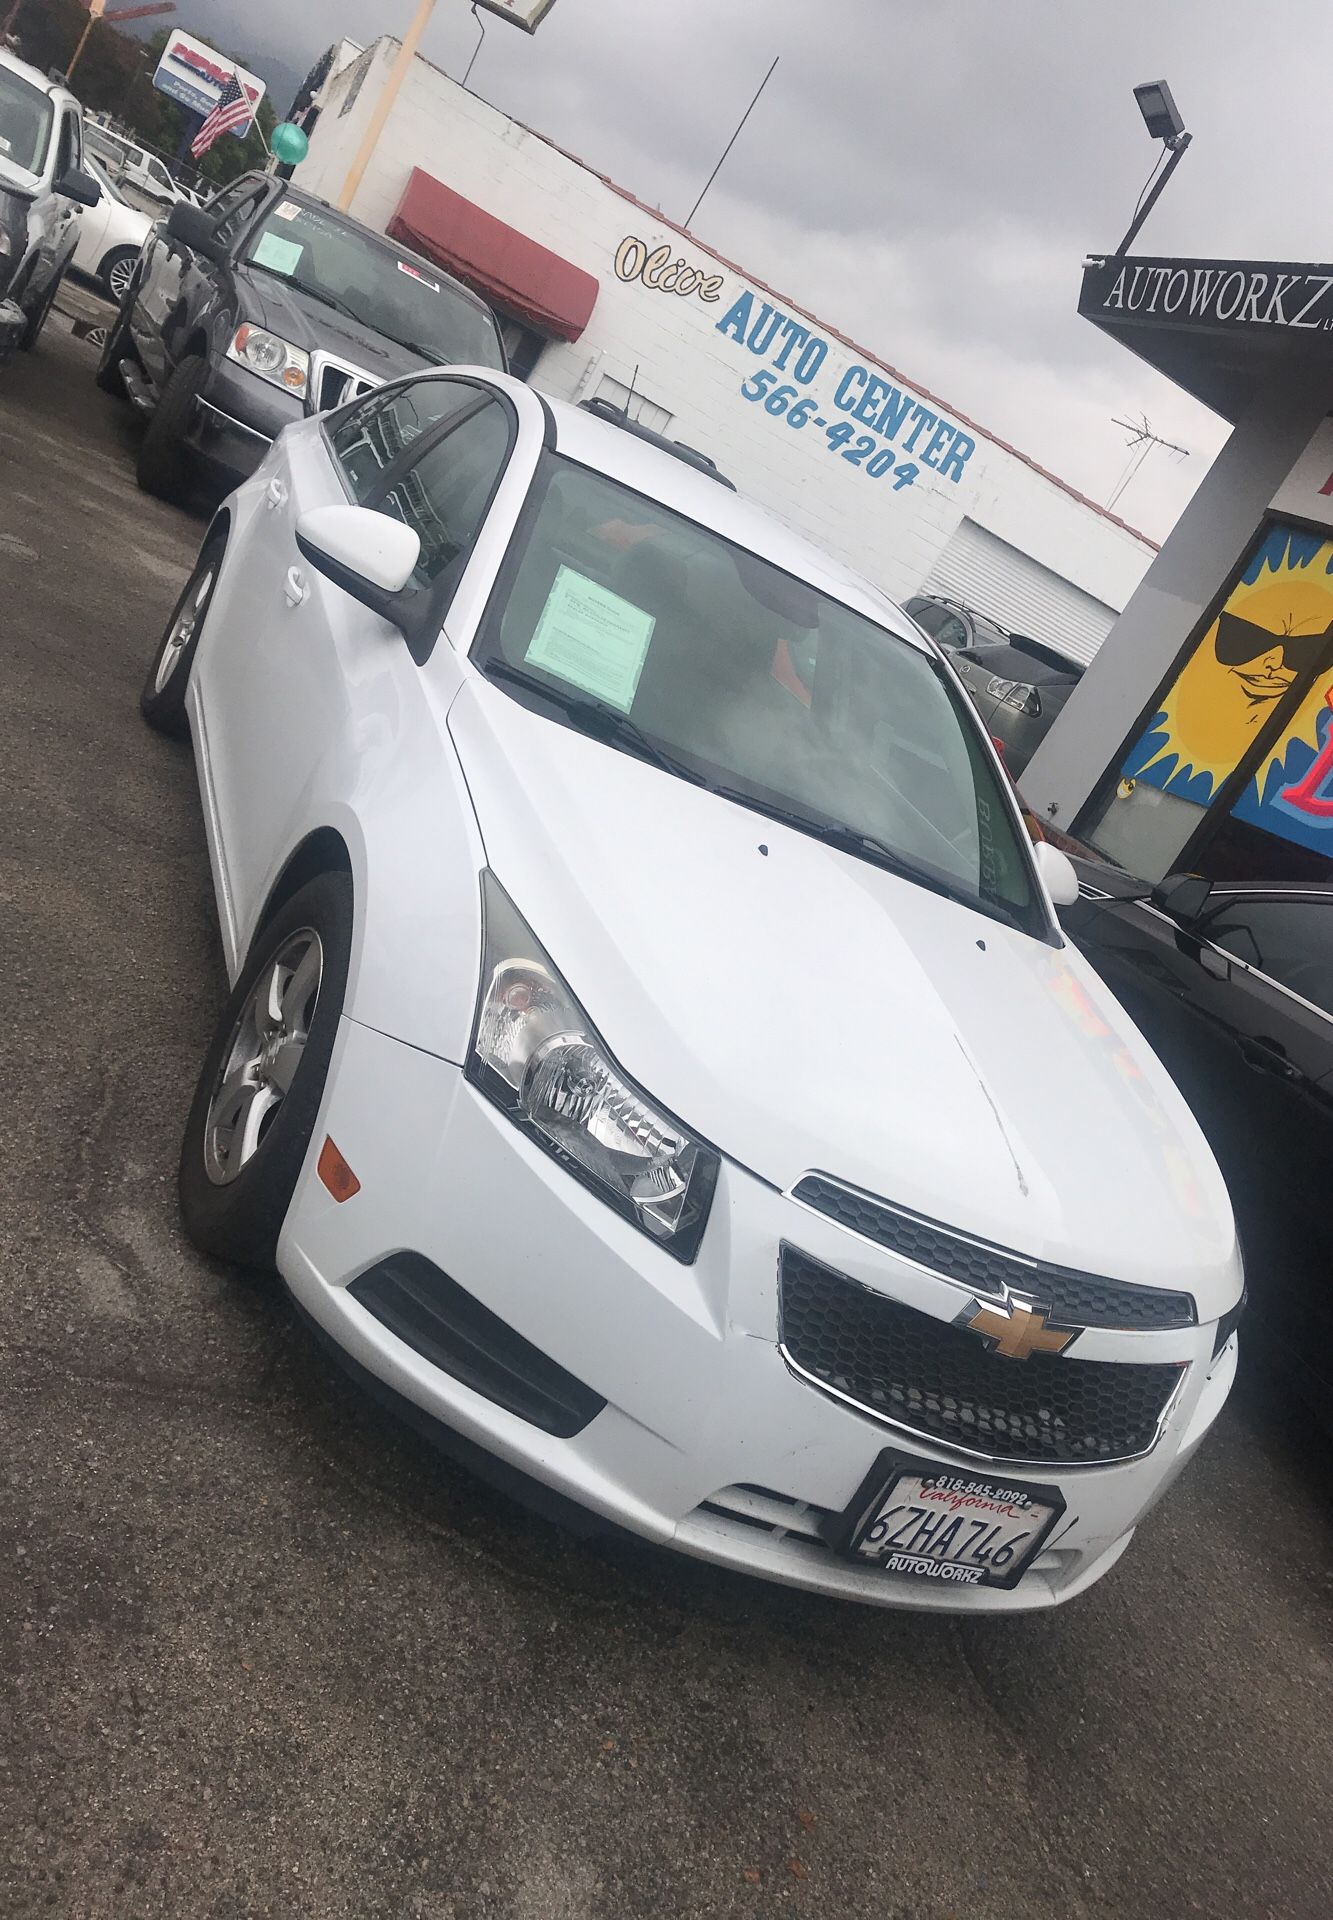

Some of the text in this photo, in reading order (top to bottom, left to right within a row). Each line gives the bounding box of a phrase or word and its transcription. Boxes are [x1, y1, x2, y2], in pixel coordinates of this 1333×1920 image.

[614, 235, 724, 303] Olive
[1103, 266, 1333, 329] AUTOWORKZ
[715, 290, 975, 484] AUTO CENTER
[740, 368, 921, 491] 566-4204
[919, 1485, 1020, 1519] California
[935, 1475, 1028, 1506] 818-845-2092
[865, 1505, 1031, 1567] 6ZHA746
[886, 1552, 985, 1584] AUTOWORKZ
